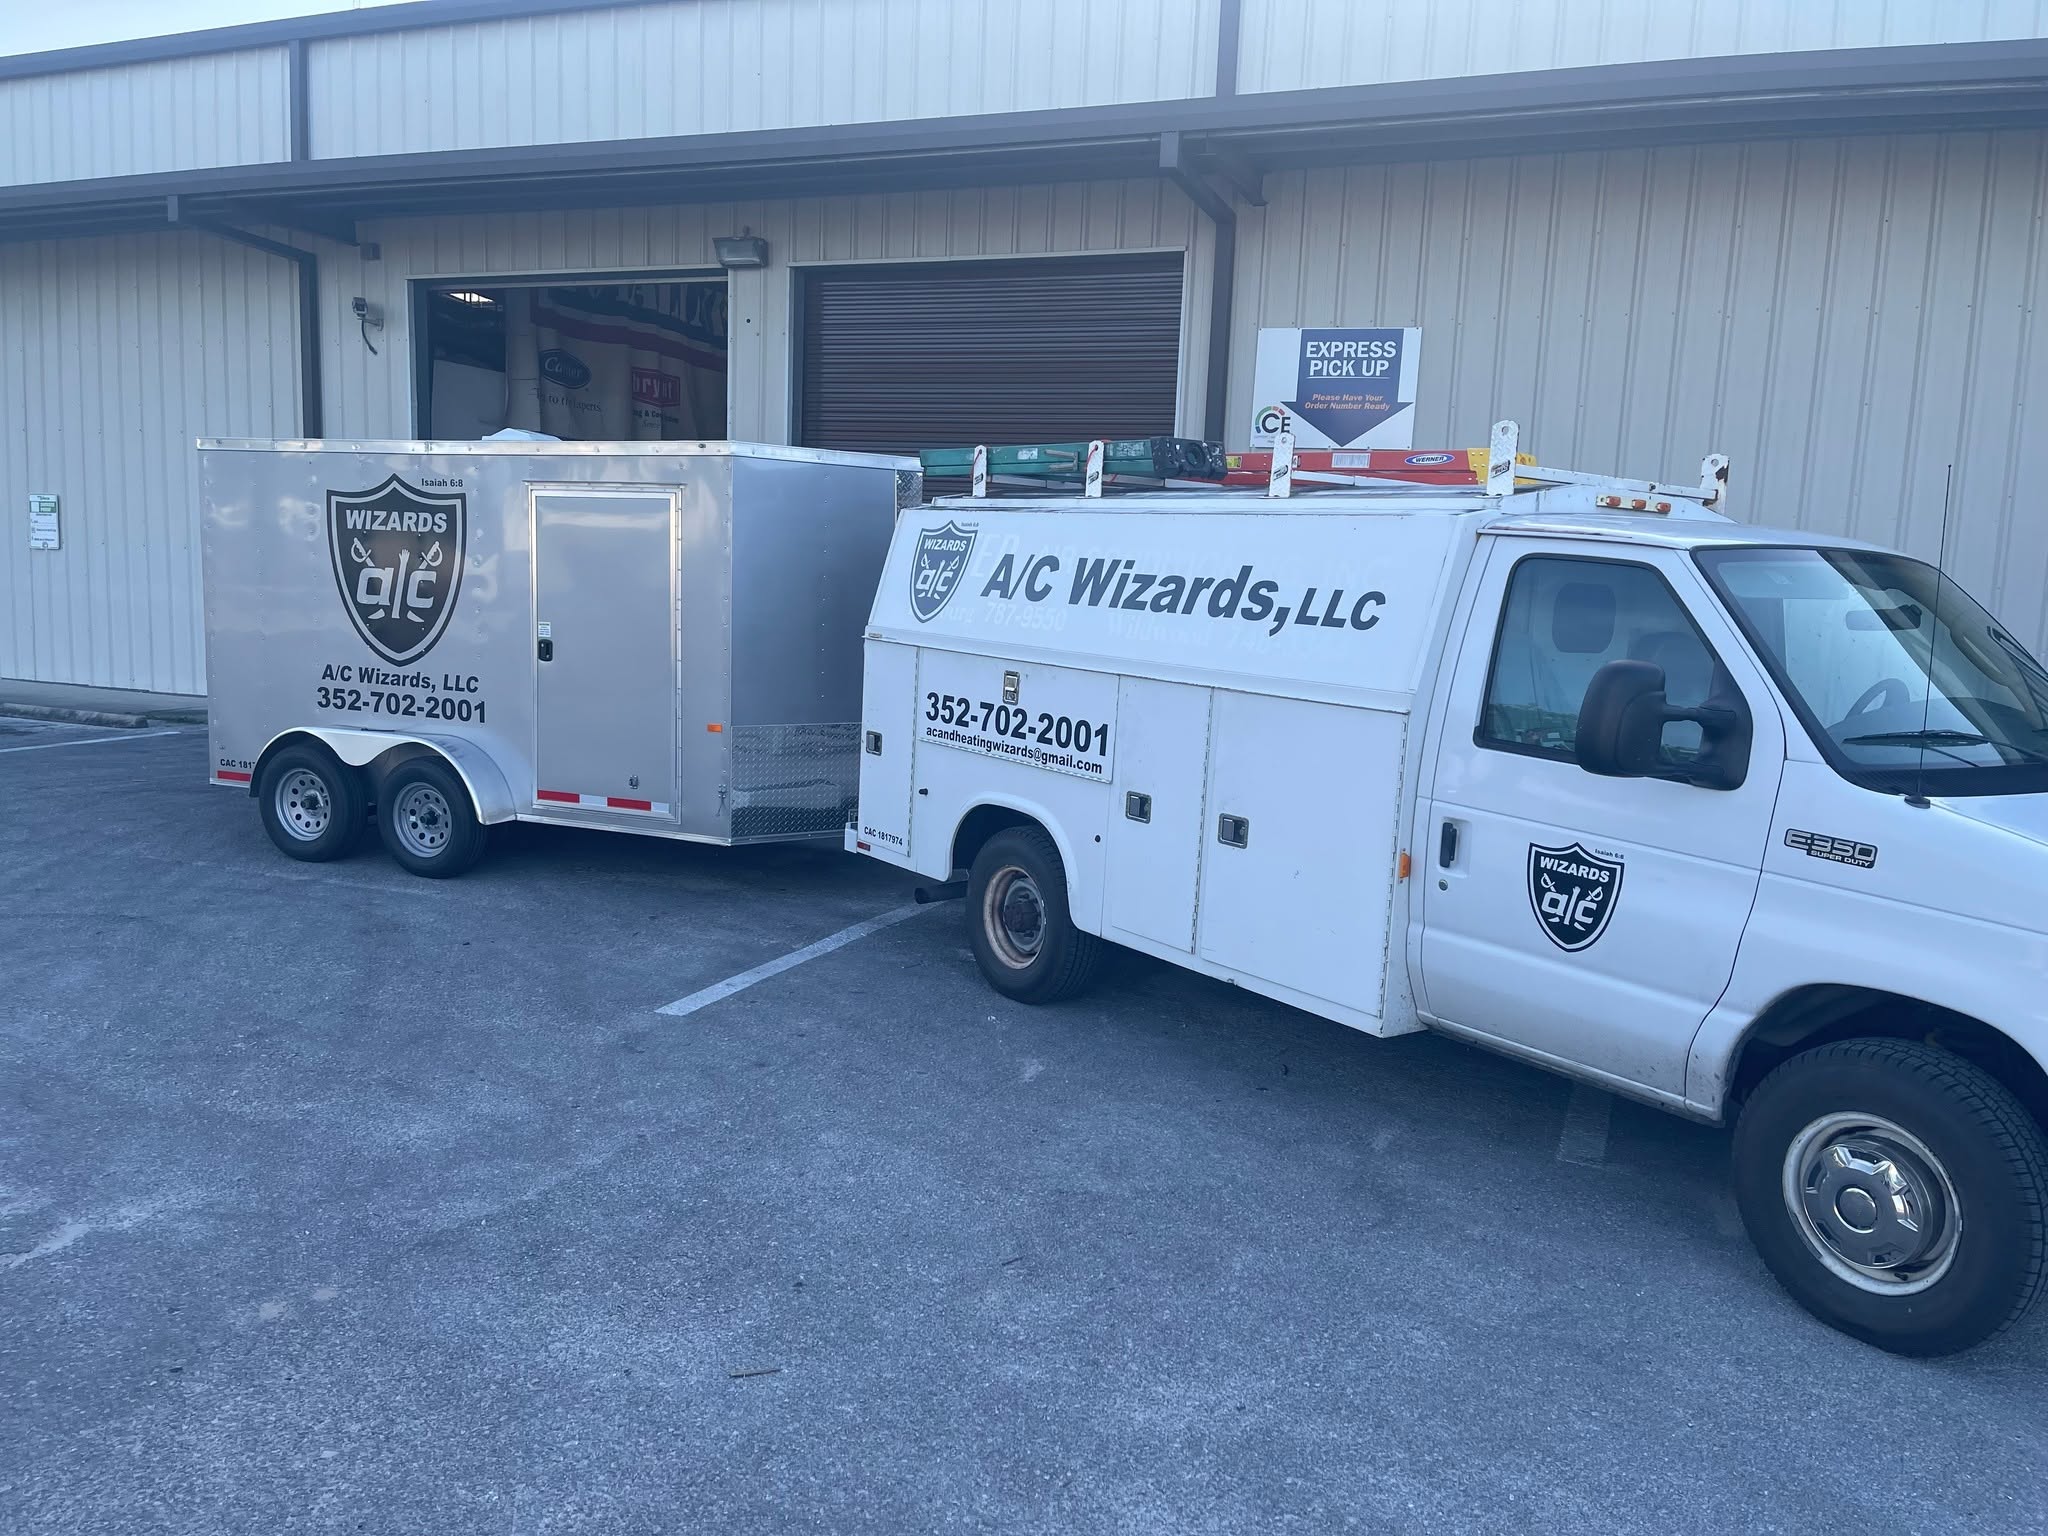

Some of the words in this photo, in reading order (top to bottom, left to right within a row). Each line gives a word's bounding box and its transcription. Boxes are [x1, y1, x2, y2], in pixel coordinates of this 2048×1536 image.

[1306, 341, 1397, 358] EXPRESS
[1309, 359, 1356, 376] PICK
[1362, 359, 1390, 376] UP
[1304, 401, 1329, 409] Order
[1329, 402, 1362, 410] Number
[1364, 402, 1391, 411] Ready
[1312, 393, 1340, 401] Please
[1342, 393, 1363, 401] Have
[1365, 393, 1384, 401] Your
[1261, 412, 1291, 434] CE
[421, 478, 448, 487] Isaiah
[449, 479, 464, 488] 6:8
[345, 509, 448, 533] WIZARDS
[923, 538, 967, 552] WIZARDS
[980, 553, 1060, 602] A/C
[1068, 556, 1291, 637] Wizards,
[1294, 588, 1387, 631] LLC
[321, 664, 352, 682] A/C
[358, 667, 437, 693] Wizards,
[443, 674, 479, 693] LLC
[316, 686, 486, 723] 352-702-2001
[925, 692, 1109, 757] 352-702-2001
[926, 727, 1103, 774] acandheatingwizards@gmail.com
[220, 758, 236, 768] CAC
[238, 760, 256, 769] 181
[864, 826, 877, 838] CAC
[877, 831, 903, 846] 1817974
[1594, 848, 1613, 857] Isaiah
[1810, 850, 1842, 862] SUPER
[1843, 857, 1871, 867] DUTY
[1540, 856, 1610, 883] WIZARDS
